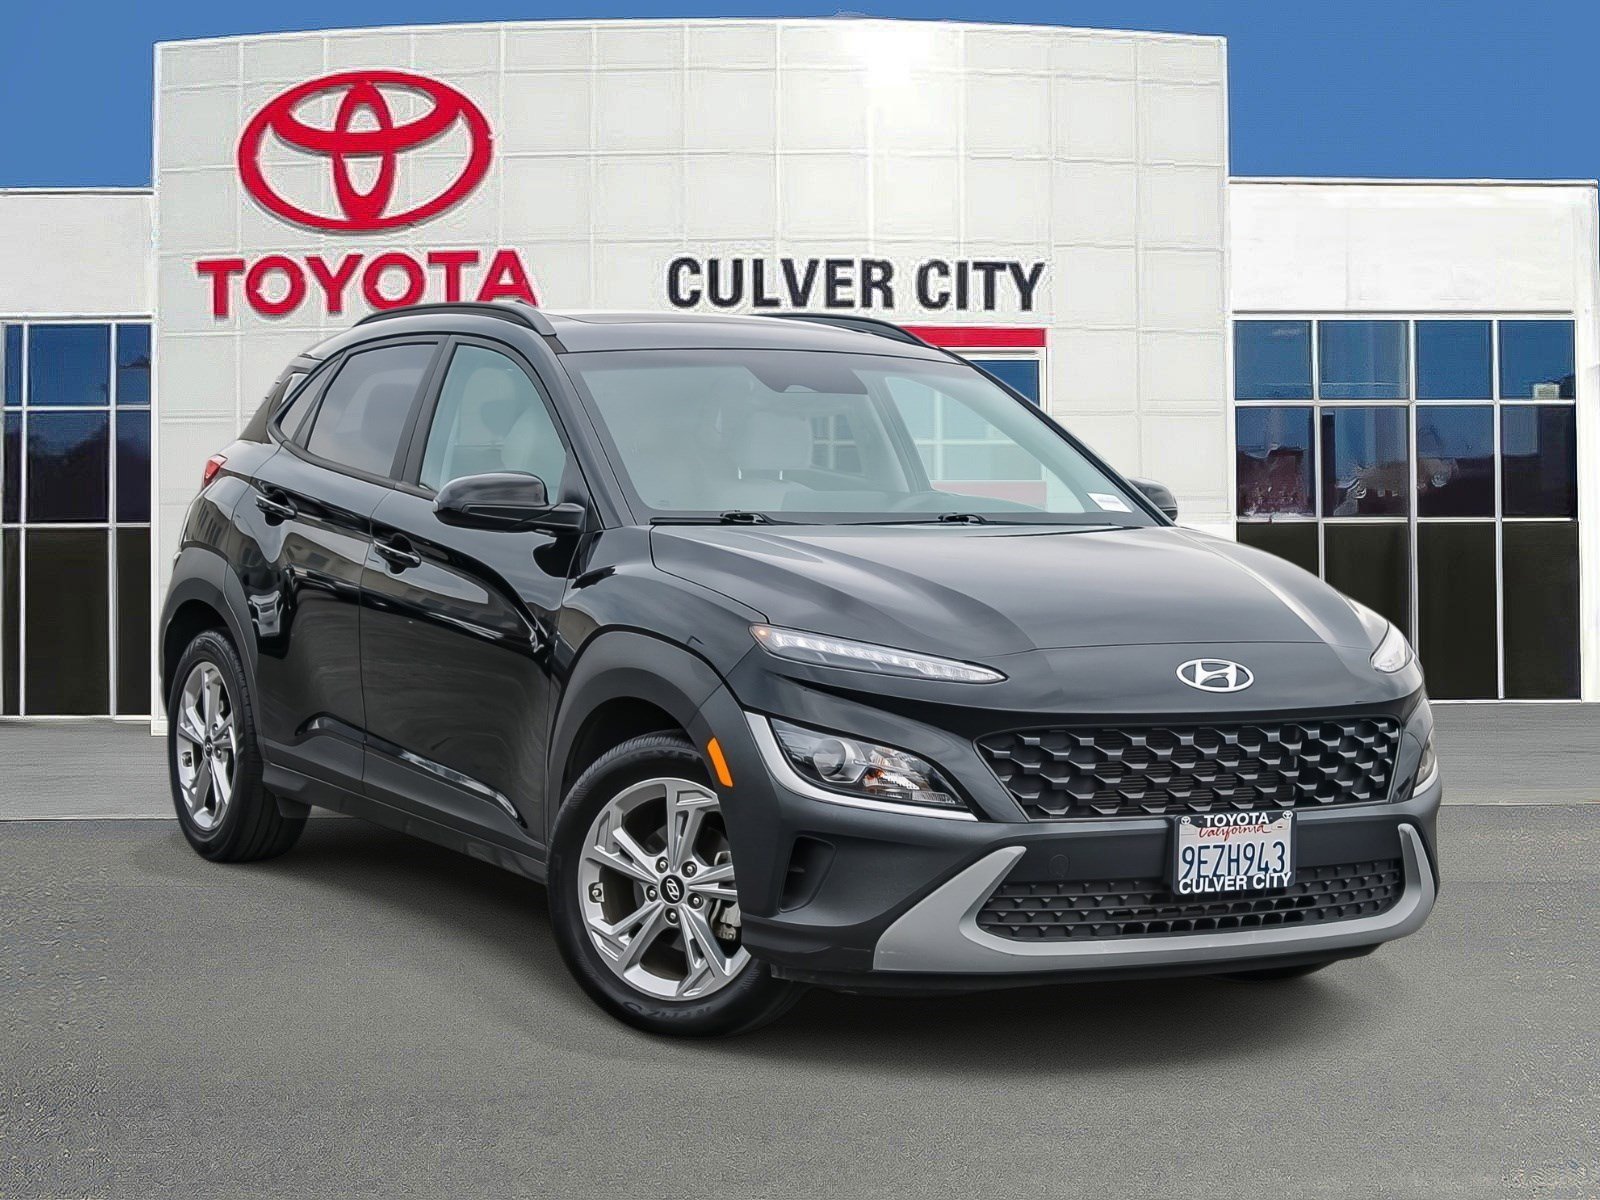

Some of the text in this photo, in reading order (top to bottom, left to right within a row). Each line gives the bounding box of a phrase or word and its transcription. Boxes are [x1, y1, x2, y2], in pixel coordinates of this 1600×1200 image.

[196, 250, 538, 319] TOYOTA
[667, 257, 1046, 311] CULVER CITY
[1199, 824, 1271, 841] California
[1203, 812, 1269, 828] TOYOTA
[1181, 841, 1285, 880] 9EZH943
[1179, 871, 1292, 895] CULVER CITY
